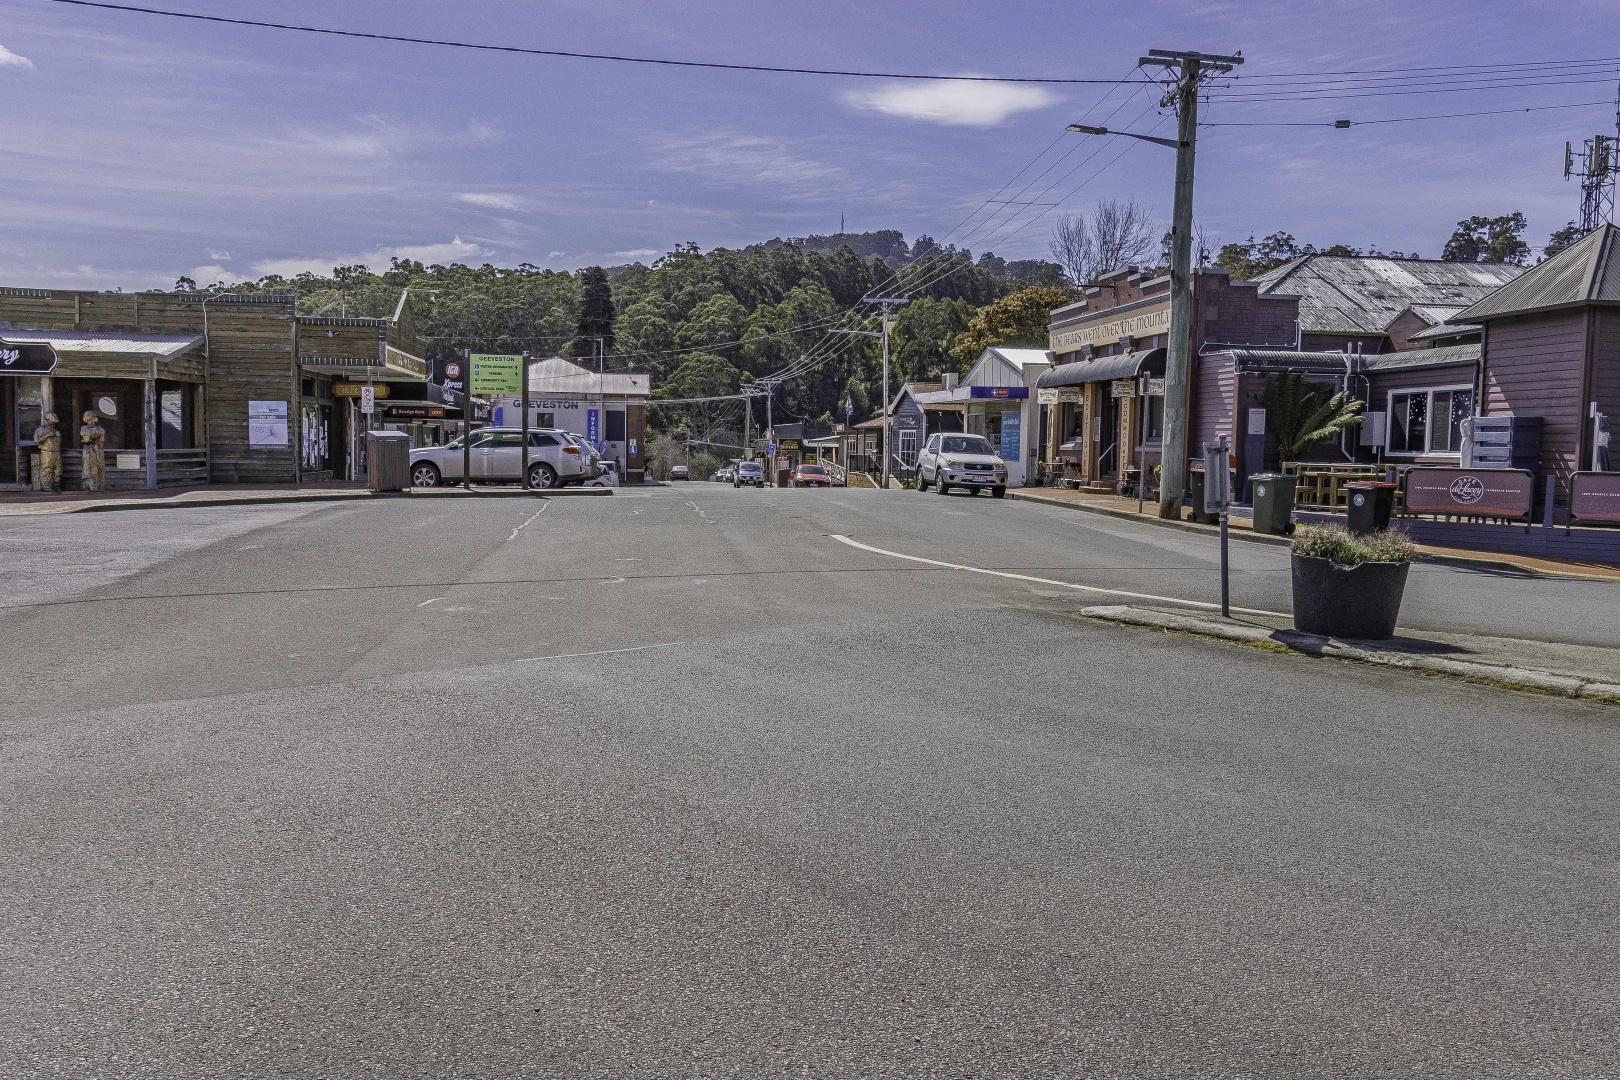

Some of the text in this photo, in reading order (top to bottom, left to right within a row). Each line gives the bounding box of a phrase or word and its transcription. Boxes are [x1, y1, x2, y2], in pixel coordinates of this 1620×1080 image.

[447, 365, 459, 375] IGA
[443, 378, 463, 389] Xpress
[512, 399, 579, 409] GEVESTON
